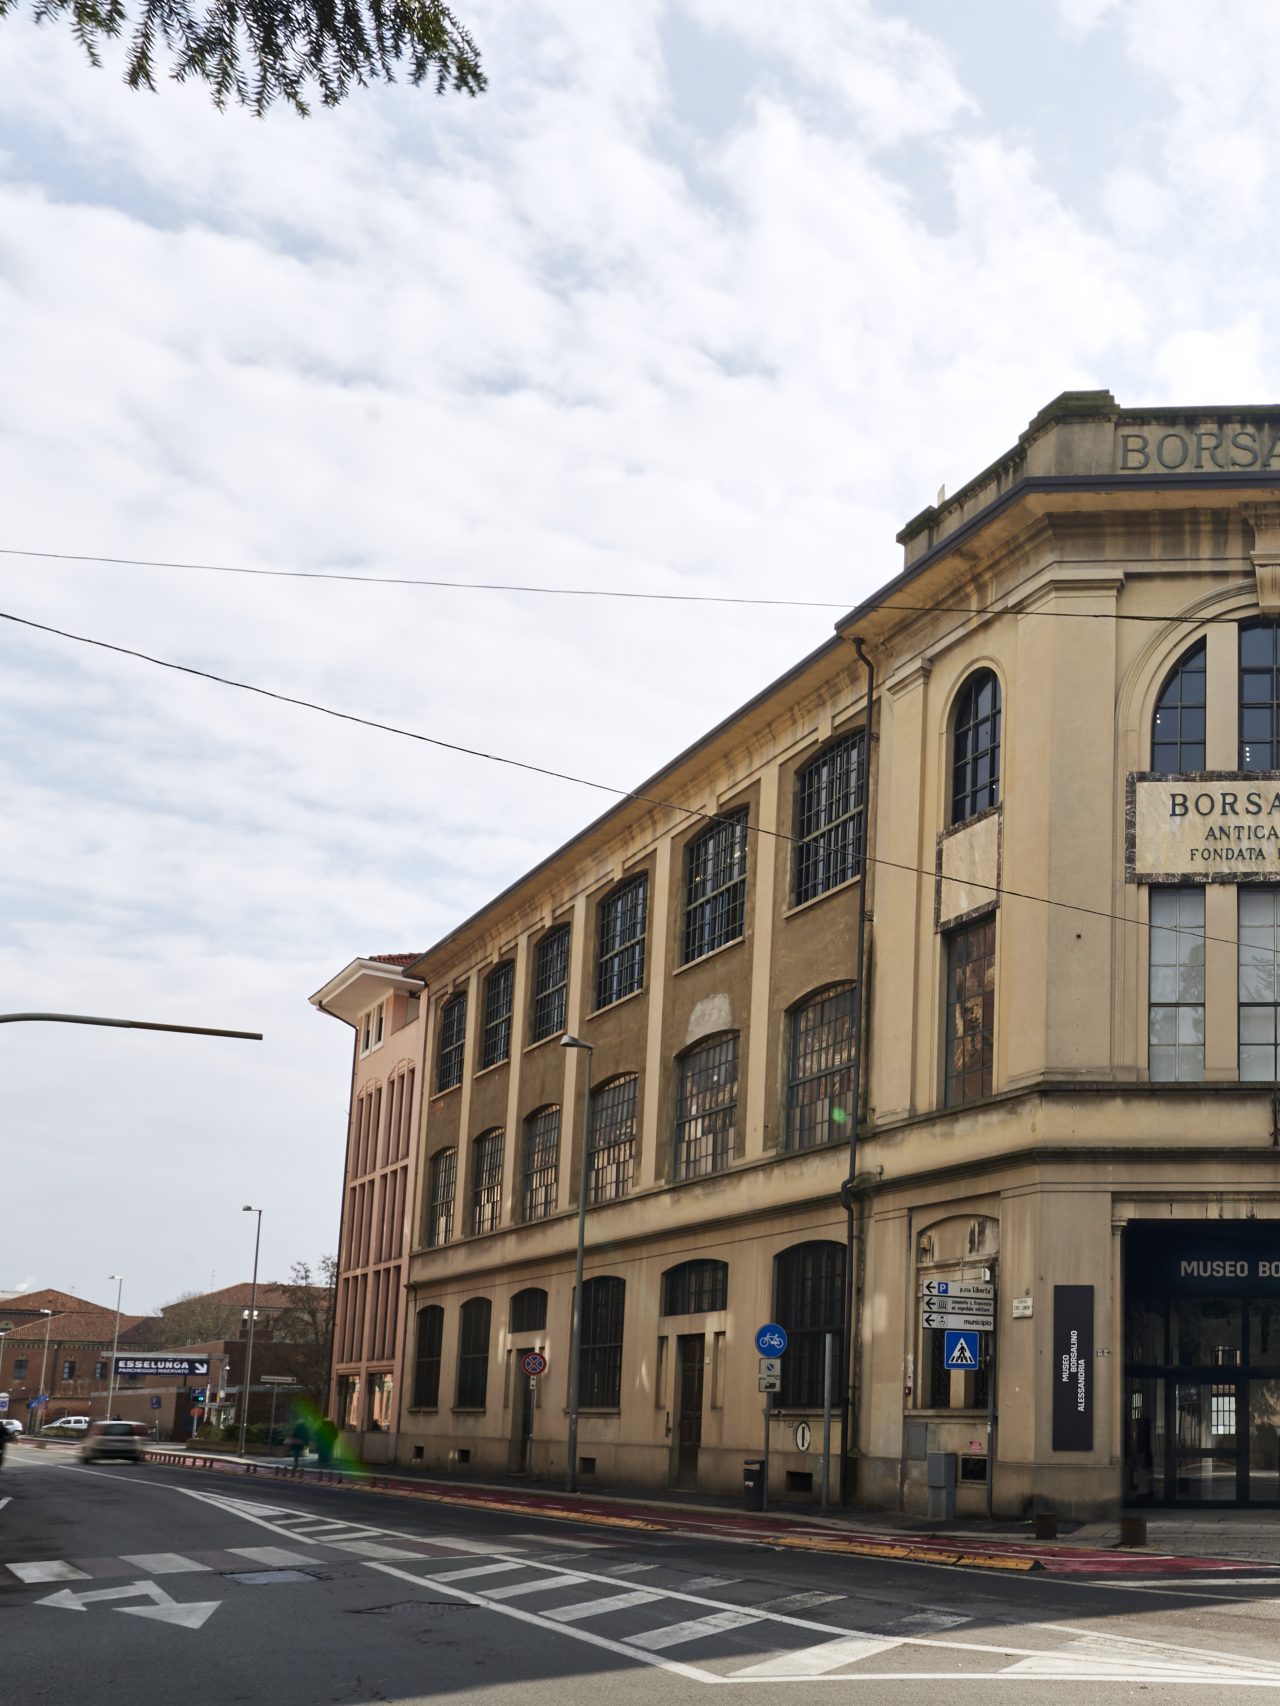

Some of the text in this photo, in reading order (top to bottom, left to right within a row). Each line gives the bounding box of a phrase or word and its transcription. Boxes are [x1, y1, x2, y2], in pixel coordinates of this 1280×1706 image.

[1205, 825, 1280, 840] ANTICA
[1190, 847, 1266, 861] FONDATA
[1180, 1260, 1249, 1278] MUSEO
[963, 1319, 992, 1327] municipio
[1070, 1330, 1078, 1373] BORSALINO
[118, 1360, 189, 1368] ESSELUNGA
[1062, 1354, 1070, 1382] MUSEO
[1077, 1358, 1085, 1412] ALESSANDRIA
